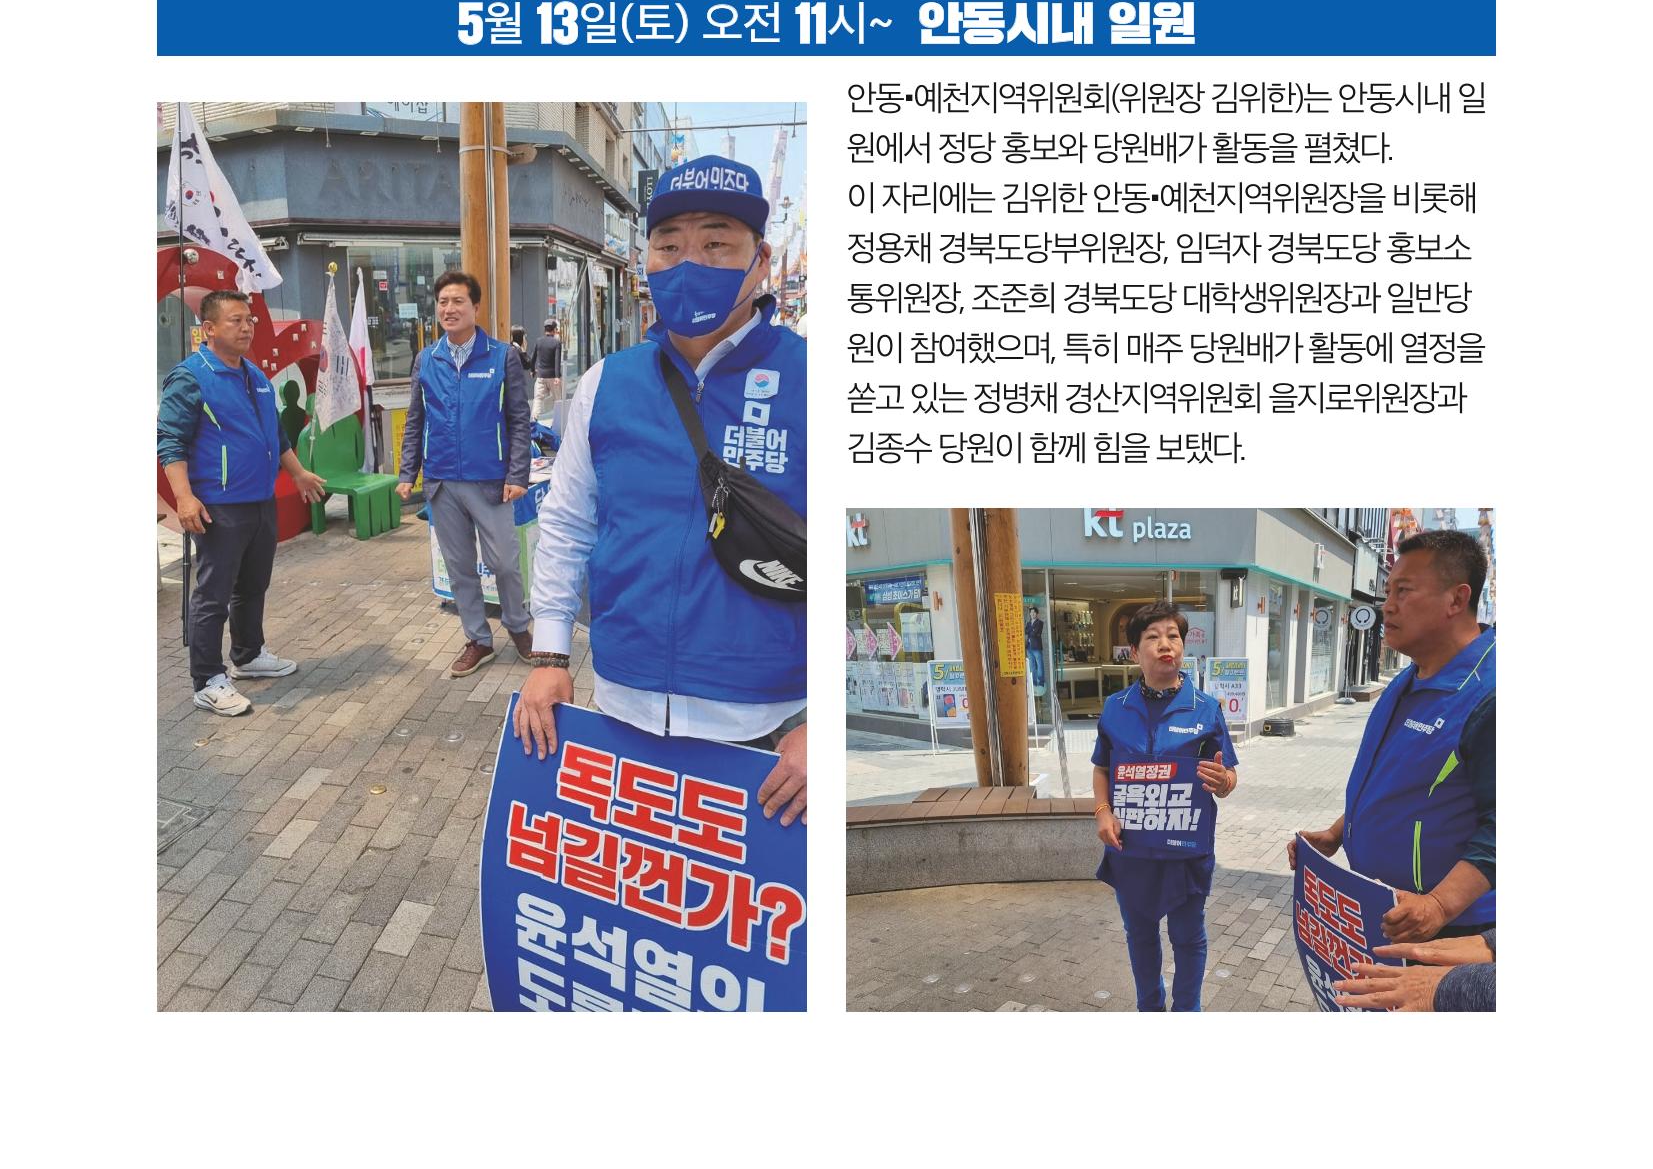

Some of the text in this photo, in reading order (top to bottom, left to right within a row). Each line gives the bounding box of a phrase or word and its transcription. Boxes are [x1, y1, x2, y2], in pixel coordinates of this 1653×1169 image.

[459, 2, 1194, 44] 5월 13일(토) 오전 11시~ 안동시내 일원
[1212, 82, 1332, 113] 김위한)는
[1339, 82, 1450, 113] 안동시내
[1459, 82, 1485, 113] 일
[848, 132, 1392, 164] 원에서 정당 홍보와 당원배가 활동을 펼쳤다.
[849, 182, 873, 213] 이
[883, 182, 995, 213] 자리에는
[1003, 182, 1087, 213] 김위한
[1394, 182, 1475, 213] 비롯해
[848, 232, 1472, 264] 정용채 경북도당부위원장, 임덕자 경북도당 홍보소
[848, 282, 1472, 314] 통위원장, 조준희 경북도당 대학생위원장과 일반당
[848, 332, 1485, 364] 원이 참여했으며, 특히 매주 당원배가 활동에 열정을
[848, 382, 1467, 414] 쏟고 있는 정병채 경산지역위원회 을지로위원장과
[724, 425, 787, 451] 더불어
[848, 432, 1244, 463] 김종수 당원이 함께 힘을 보탰다.
[723, 446, 788, 473] 민주당
[846, 513, 869, 547] kt
[1084, 508, 1192, 543] kt plaza
[757, 560, 804, 590] NIKE
[1117, 764, 1172, 780] 윤석열정권
[556, 741, 748, 864] 독도도
[1113, 783, 1193, 807] 굴욕외교
[506, 800, 806, 966] 넘길껀가?
[1304, 865, 1367, 949] 독도도
[1296, 900, 1375, 980] 넘길껀가
